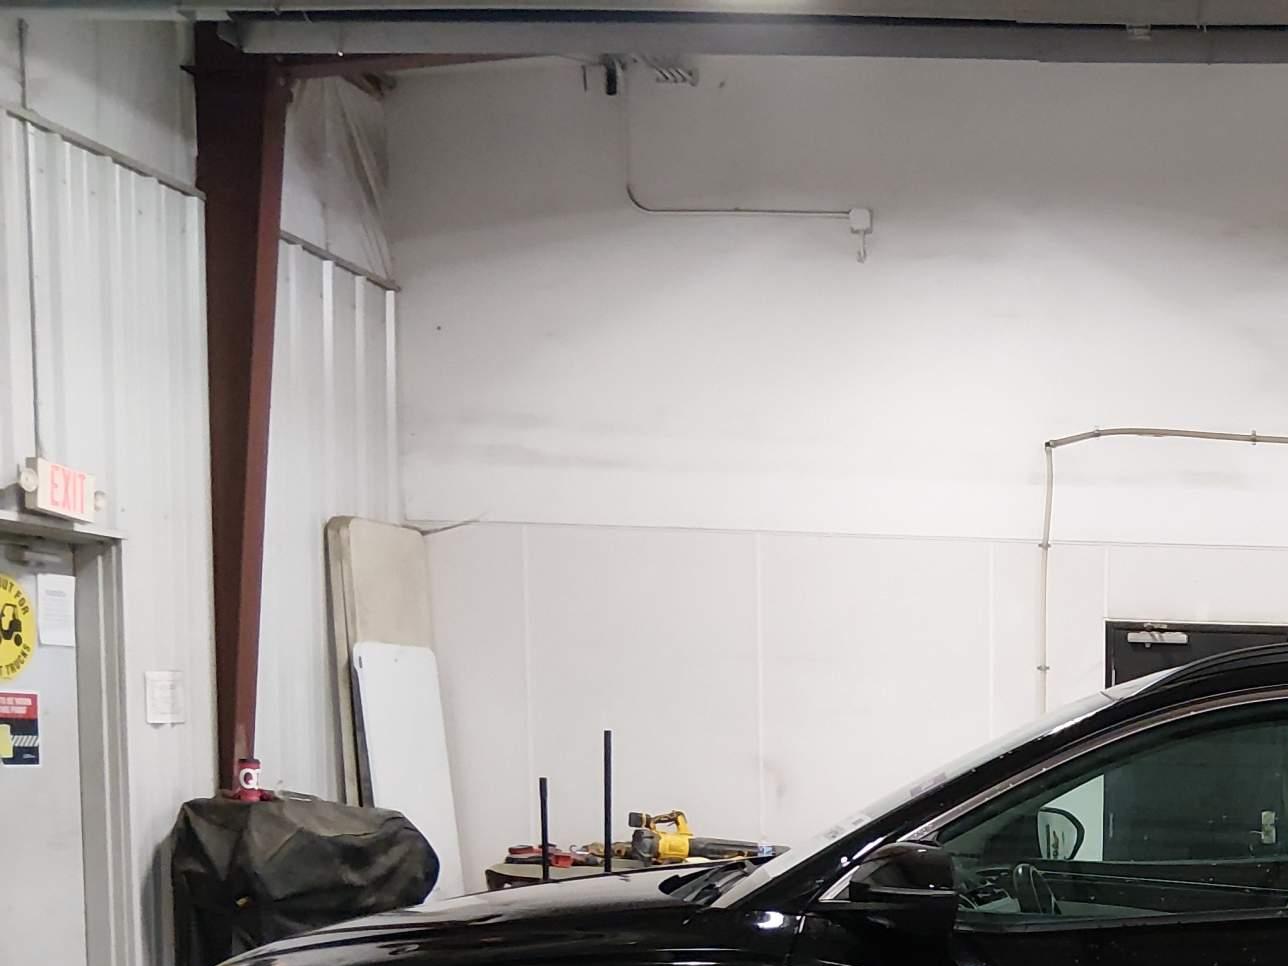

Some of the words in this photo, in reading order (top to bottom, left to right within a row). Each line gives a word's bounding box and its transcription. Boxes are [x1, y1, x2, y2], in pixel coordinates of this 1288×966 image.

[50, 464, 86, 514] EXIT
[14, 589, 30, 615] FOR
[4, 643, 31, 676] TRUCKS
